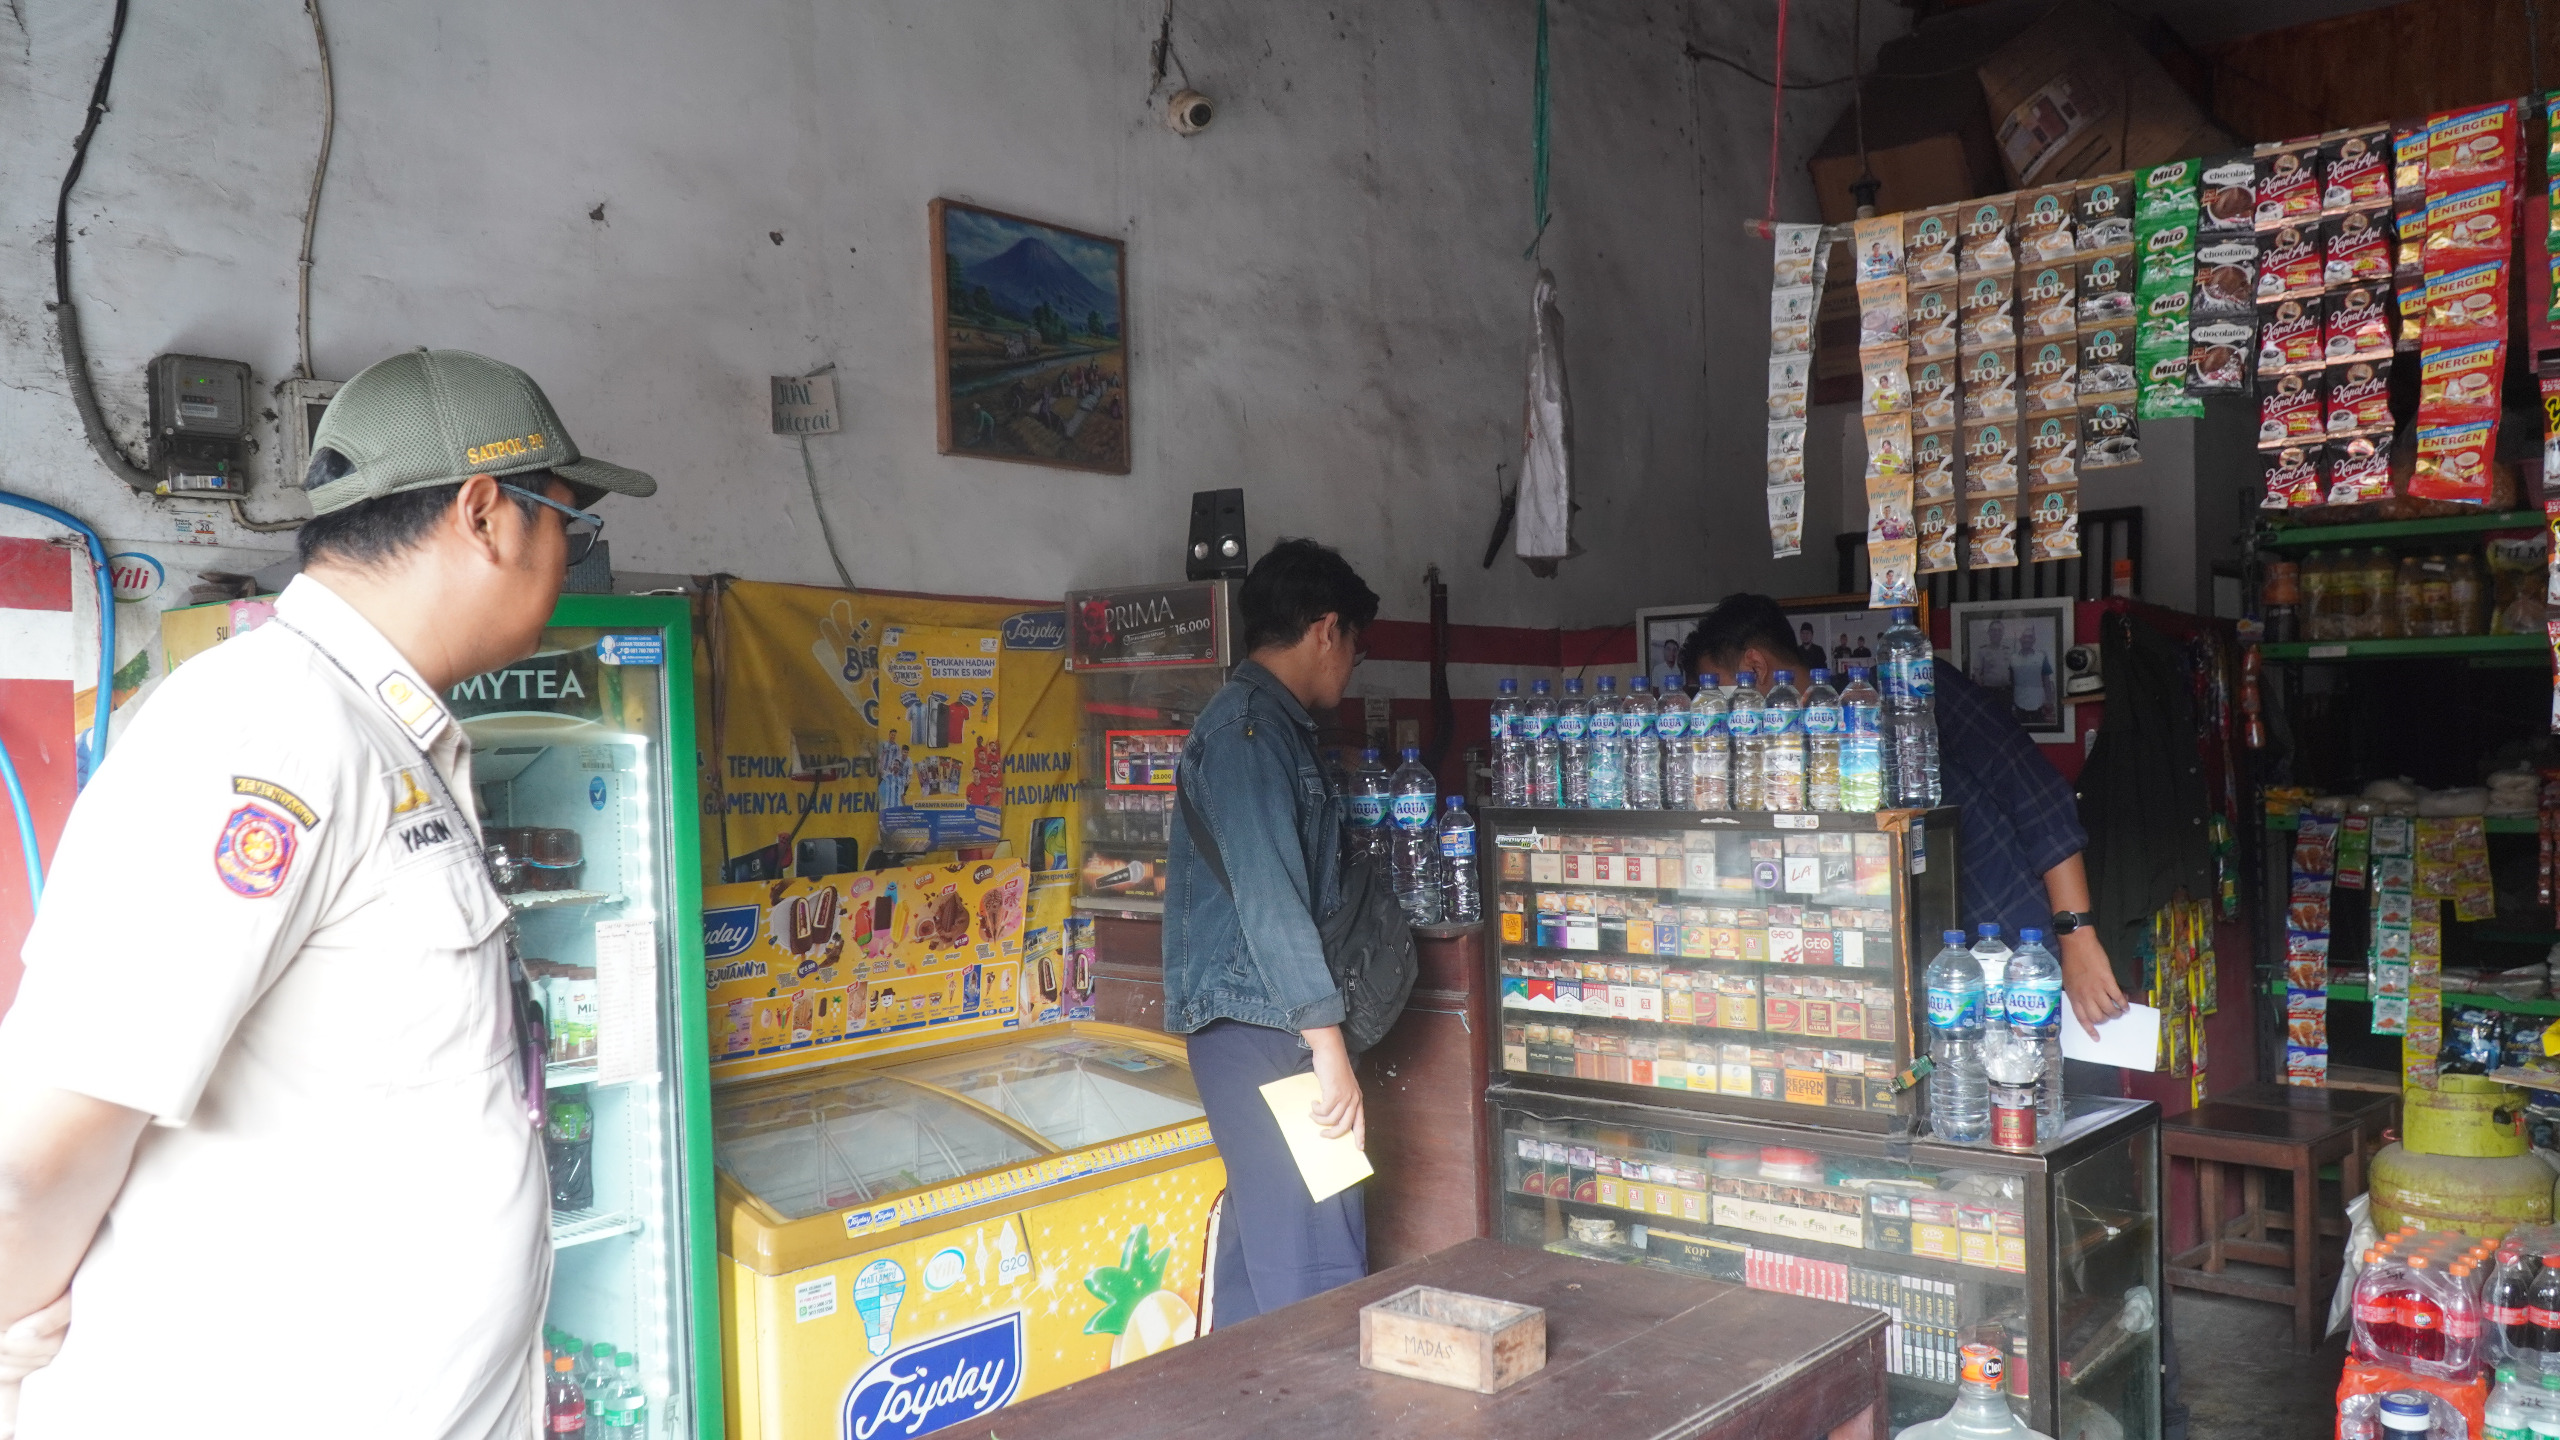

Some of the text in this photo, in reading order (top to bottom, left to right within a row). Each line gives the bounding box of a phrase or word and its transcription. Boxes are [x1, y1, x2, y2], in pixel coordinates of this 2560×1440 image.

[2436, 117, 2498, 140] ENERGEN
[2153, 167, 2183, 182] MILO
[2210, 167, 2253, 180] chocolato
[2327, 152, 2380, 180] Kapal Api
[2260, 168, 2311, 195] Kapal Api
[2083, 197, 2120, 215] TOP
[2433, 195, 2495, 218] ENERGEN
[2027, 208, 2063, 227] TOP
[1967, 219, 2003, 237] TOP
[1913, 229, 1948, 247] TOP
[2153, 232, 2184, 247] MILO
[2328, 227, 2382, 254] Kapal Api
[2262, 242, 2313, 267] Kapal Api
[2084, 270, 2120, 287] TOP
[2433, 272, 2492, 295] ENERGEN
[2029, 281, 2065, 299] TOP
[1968, 290, 2003, 309] TOP
[2154, 298, 2185, 312] MILO
[1914, 304, 1948, 321] TOP
[2331, 303, 2383, 329] Kapal Api
[2263, 315, 2314, 340] Kapal Api
[2086, 342, 2123, 360] TOP
[2031, 355, 2067, 374] TOP
[2155, 363, 2187, 377] MILO
[2428, 353, 2489, 373] ENERGEN
[1971, 364, 2005, 383] TOP
[1915, 376, 1945, 394] TOP
[2333, 378, 2387, 403] Kapal Api
[2264, 389, 2316, 413] Kapal Api
[2089, 416, 2126, 432] TOP
[2034, 434, 2068, 450] TOP
[2423, 432, 2481, 448] ENERGEN
[467, 438, 527, 465] SATPOL
[1916, 448, 1943, 464] TOP
[1972, 442, 2007, 457] TOP
[2266, 462, 2315, 485] Kapal Api
[2334, 453, 2388, 476] Kapal Api
[1974, 513, 2005, 529] TOP
[2035, 508, 2068, 524] TOP
[1922, 518, 1946, 534] TOP
[109, 566, 150, 589] Yili
[1104, 596, 1174, 632] PRIMA
[1008, 617, 1064, 644] Joyday
[1175, 618, 1210, 635] 16.000
[926, 658, 964, 667] TEMUKAN
[966, 659, 995, 667] HADIAH
[452, 669, 585, 700] MYTEA
[1559, 720, 1581, 731] AQUA
[1591, 717, 1615, 728] AQUA
[1659, 717, 1681, 728] AQUA
[1730, 715, 1754, 725] AQUA
[1807, 712, 1834, 723] AQUA
[1003, 752, 1071, 773] MAINKAN
[1005, 783, 1079, 805] HADIAHNY
[1396, 801, 1427, 818] AQUA
[1804, 937, 1831, 950] GEO
[1833, 931, 1843, 965] ARES
[2009, 994, 2046, 1010] AQUA
[1786, 1077, 1824, 1089] REGION
[1786, 1086, 1823, 1096] KRETEK
[1685, 1245, 1710, 1258] KOPI
[1001, 1254, 1028, 1272] G20
[1986, 1362, 2001, 1374] Cleo
[854, 1358, 1005, 1440] Joyday
